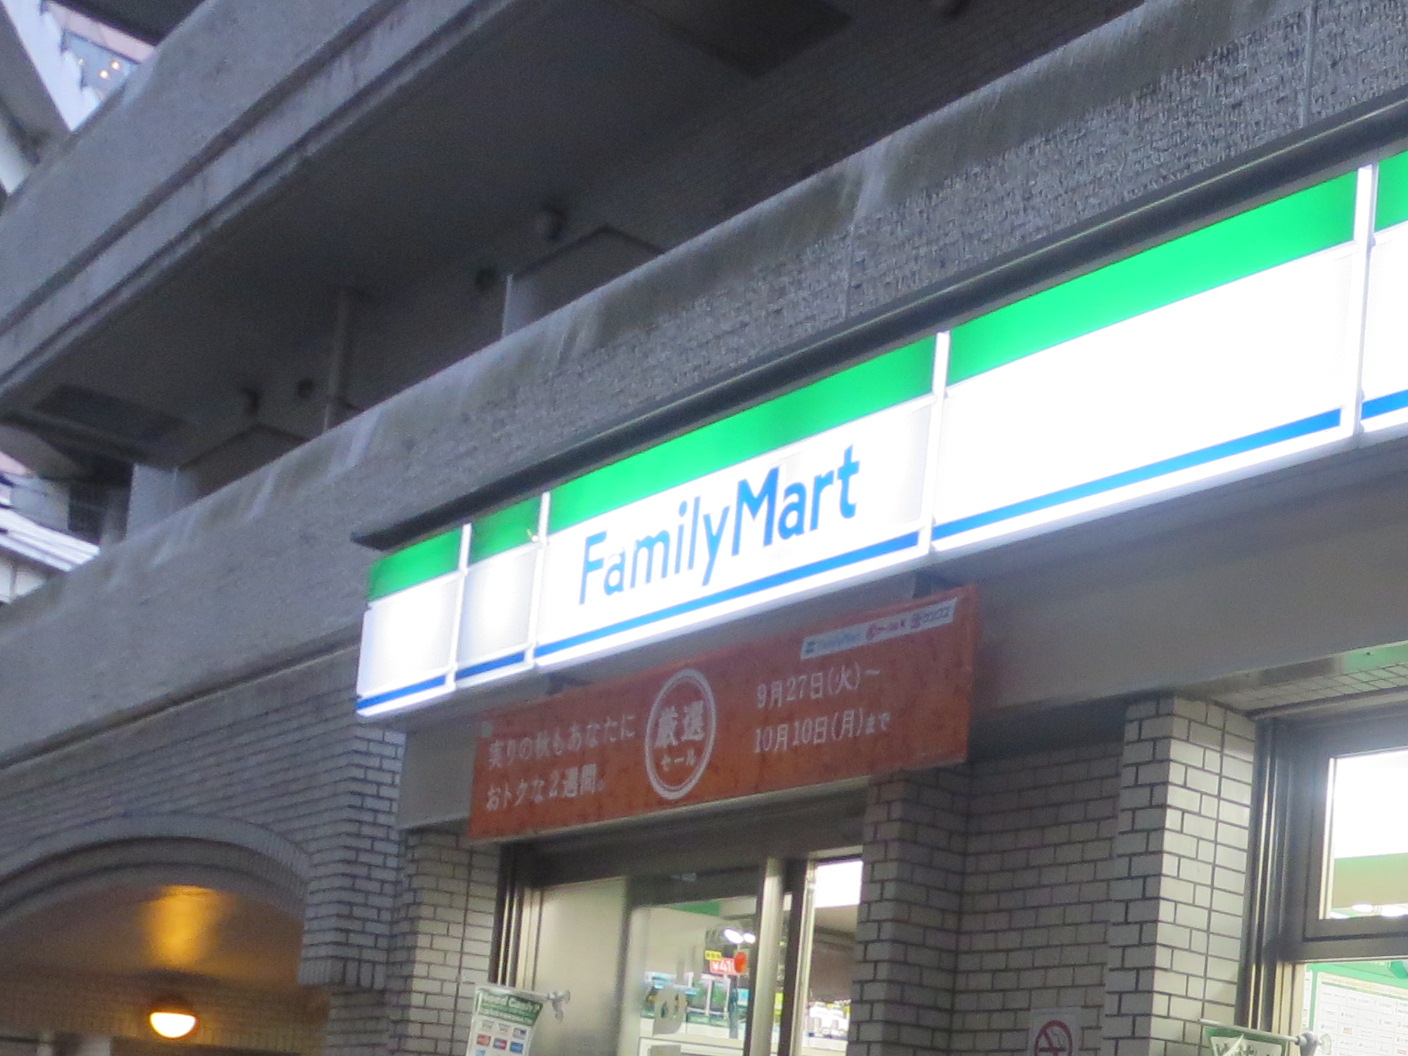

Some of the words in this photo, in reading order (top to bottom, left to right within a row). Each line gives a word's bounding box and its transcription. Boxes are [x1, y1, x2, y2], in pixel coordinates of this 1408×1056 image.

[578, 444, 861, 605] FamilyMart
[488, 714, 636, 770] 実りの秋もあなたに
[654, 700, 706, 749] 厳選
[660, 754, 696, 772] セール
